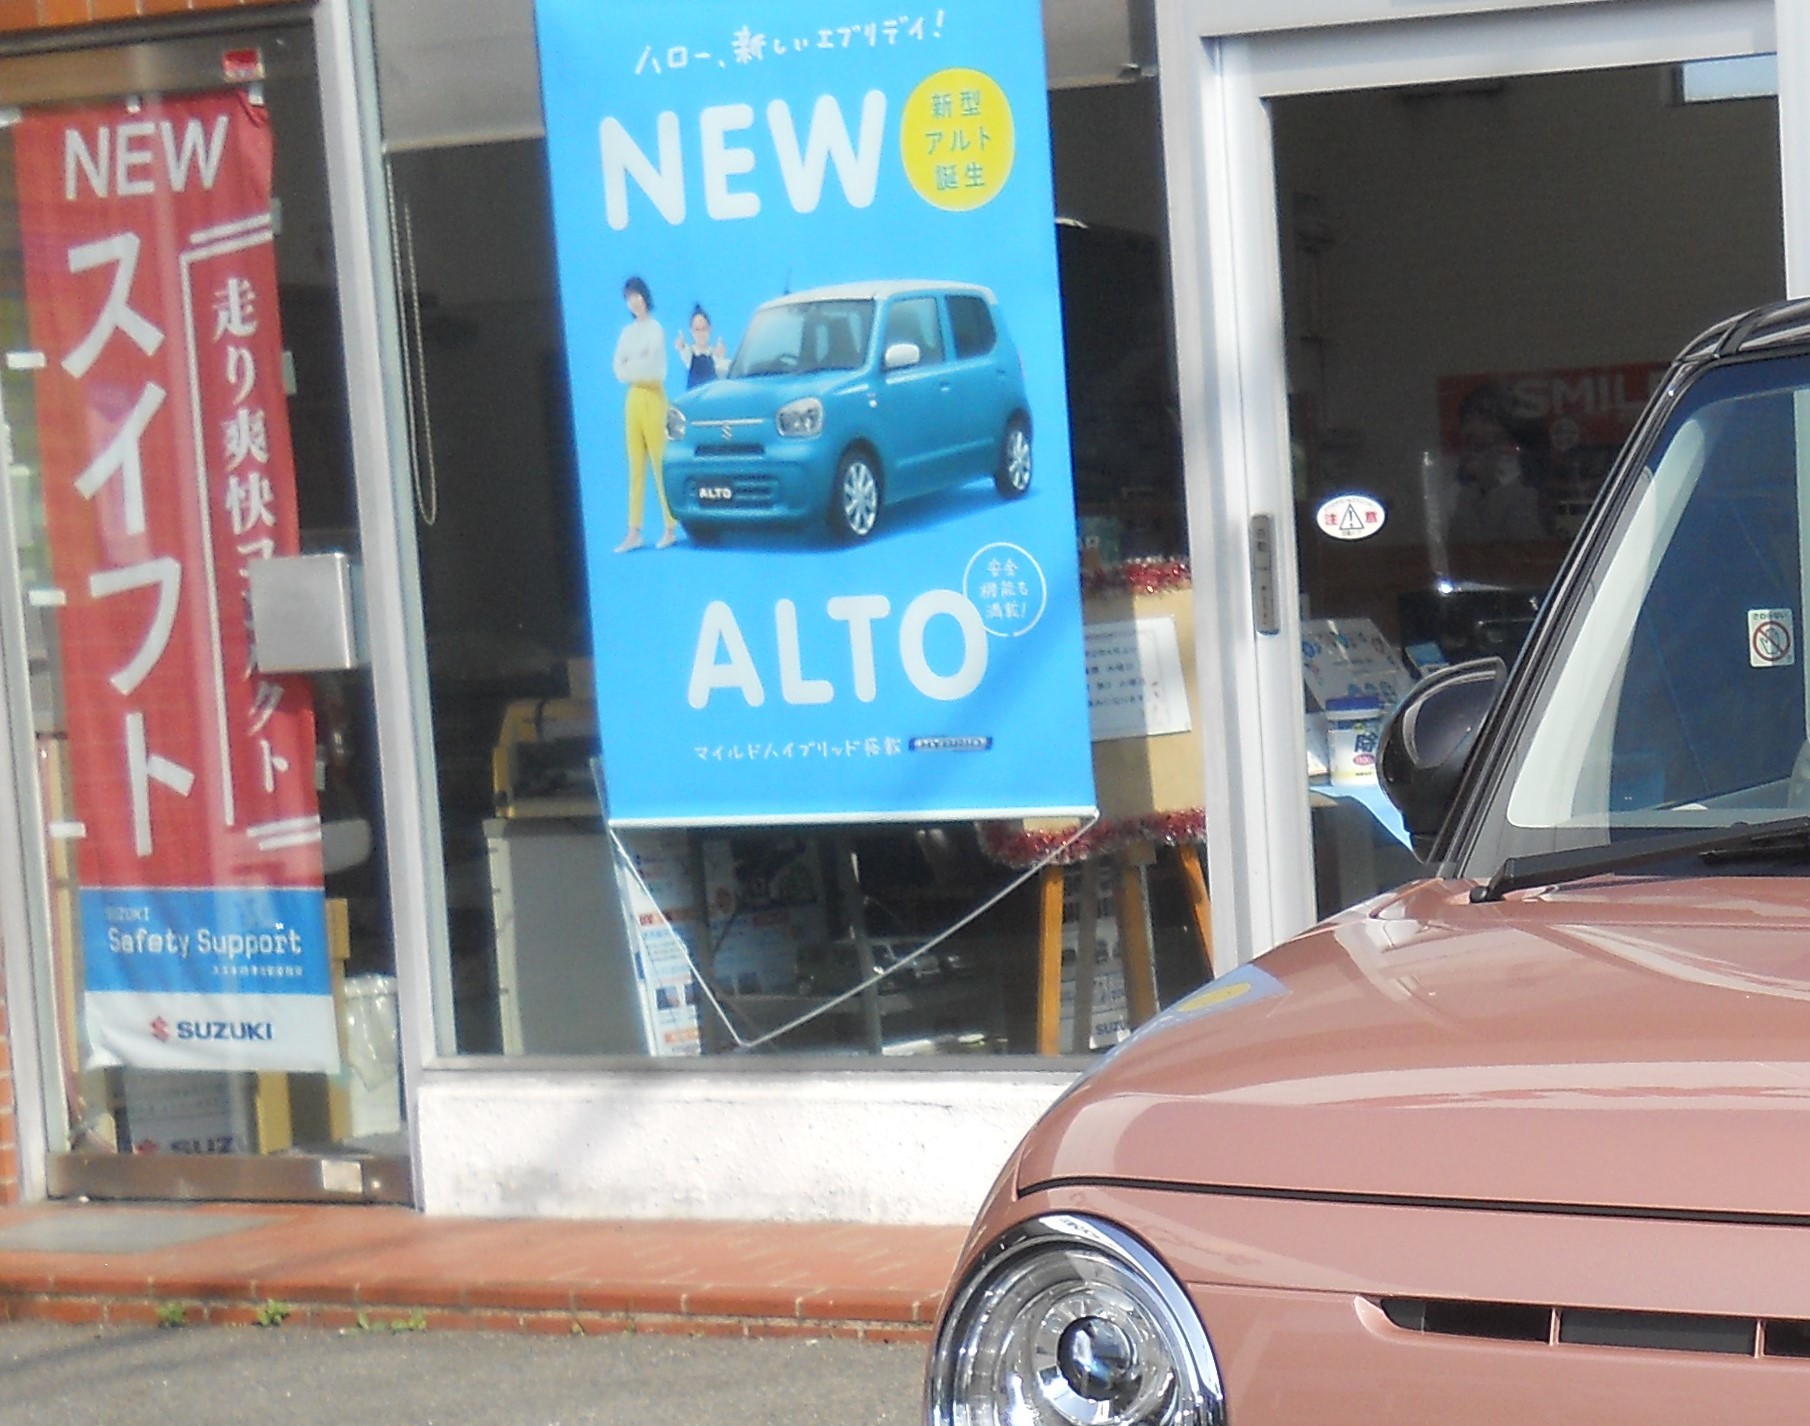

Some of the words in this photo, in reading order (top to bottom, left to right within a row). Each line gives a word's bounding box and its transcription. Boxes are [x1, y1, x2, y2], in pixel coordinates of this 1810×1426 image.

[930, 91, 982, 120] 新型
[925, 126, 992, 155] アルト
[64, 115, 229, 200] NEW
[599, 89, 887, 231] NEW
[936, 163, 986, 191] 誕生
[698, 486, 732, 500] ALTO
[61, 232, 195, 857] スイフト
[688, 588, 989, 709] ALTO
[108, 926, 190, 959] Safety
[197, 926, 302, 960] Support
[176, 1020, 273, 1041] SUZUKI
